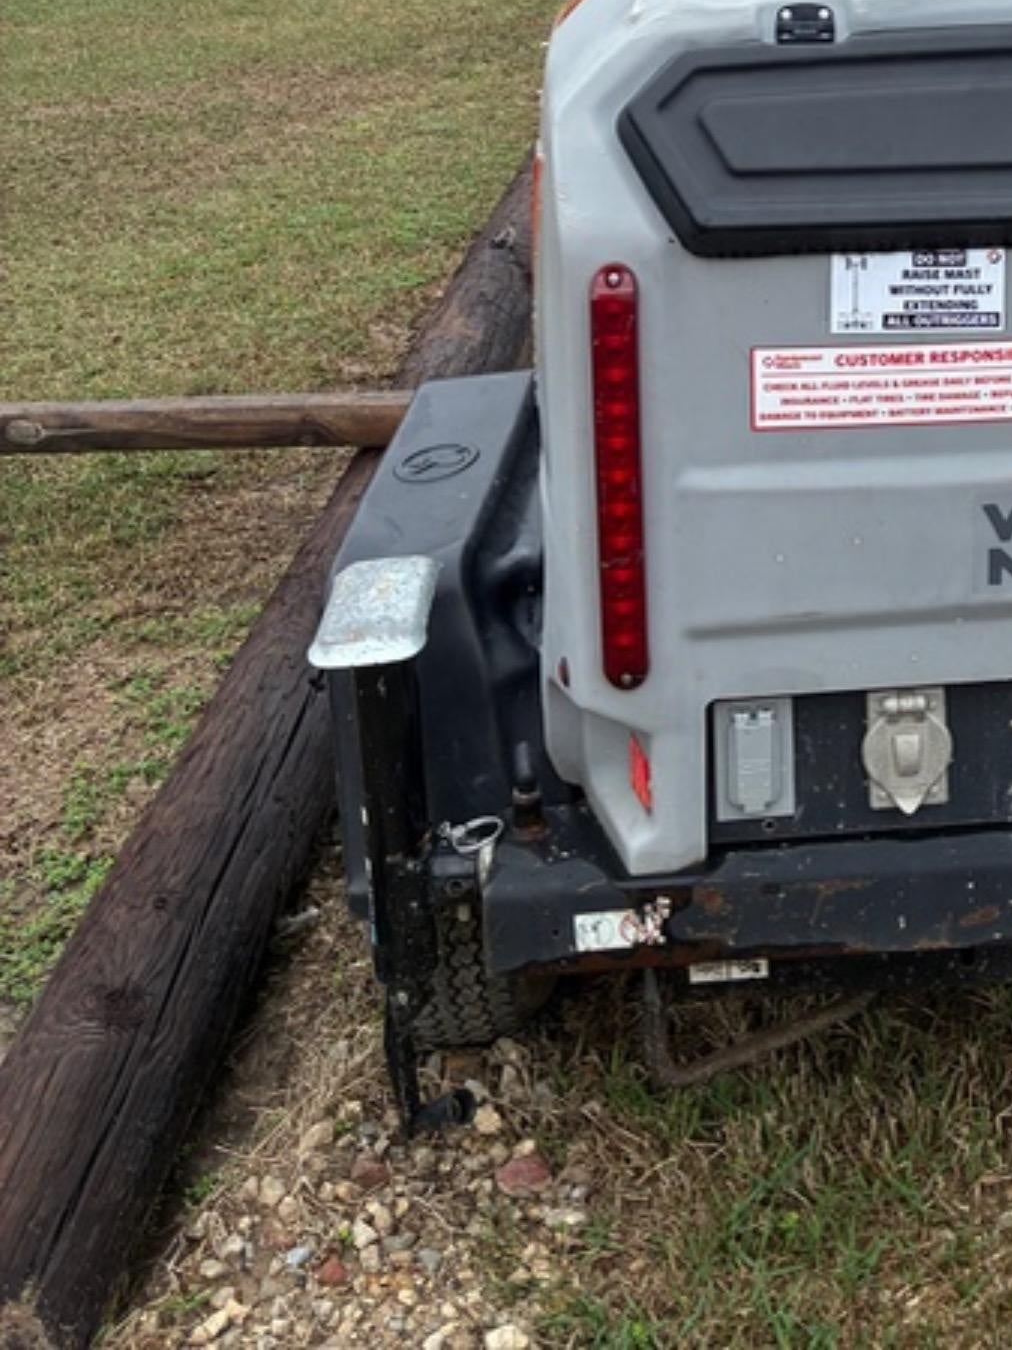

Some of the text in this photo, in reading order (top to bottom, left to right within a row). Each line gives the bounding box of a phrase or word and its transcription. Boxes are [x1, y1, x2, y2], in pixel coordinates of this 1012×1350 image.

[914, 252, 964, 266] DO NOT
[902, 268, 981, 280] RAISE MAST
[888, 284, 993, 296] WITHOUT FULLY
[903, 300, 979, 310] EXTENDING
[886, 313, 997, 328] ALL OUTRIGGERS
[834, 352, 924, 367] CUSTOMER
